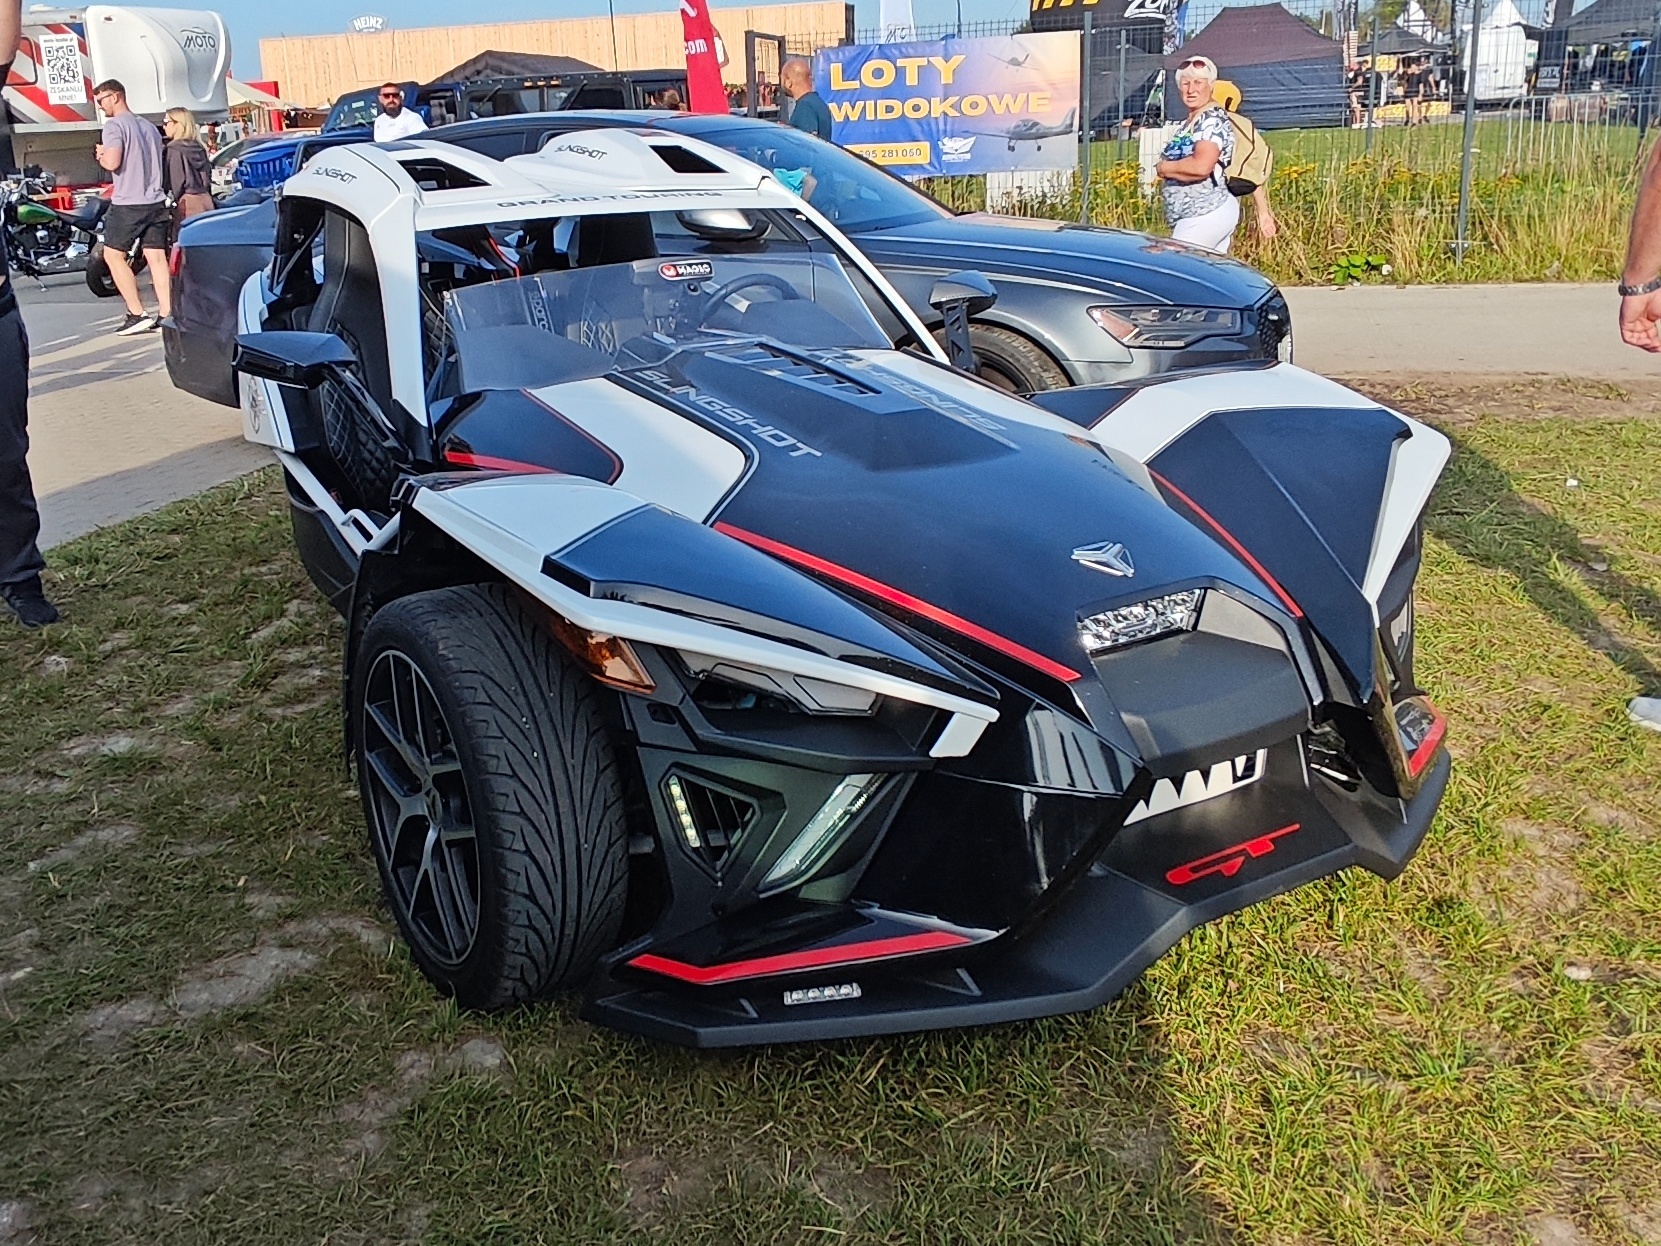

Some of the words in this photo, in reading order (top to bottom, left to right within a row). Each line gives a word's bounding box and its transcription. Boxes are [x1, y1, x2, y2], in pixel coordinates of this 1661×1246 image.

[353, 15, 383, 31] HEINZ
[183, 35, 216, 49] MOTO
[830, 55, 966, 91] LOTY
[828, 92, 1052, 123] WIDOKOWE
[881, 149, 899, 158] 281
[496, 196, 600, 208] GRAND
[602, 191, 723, 200] TOURING
[634, 369, 823, 457] SLINGSHOT
